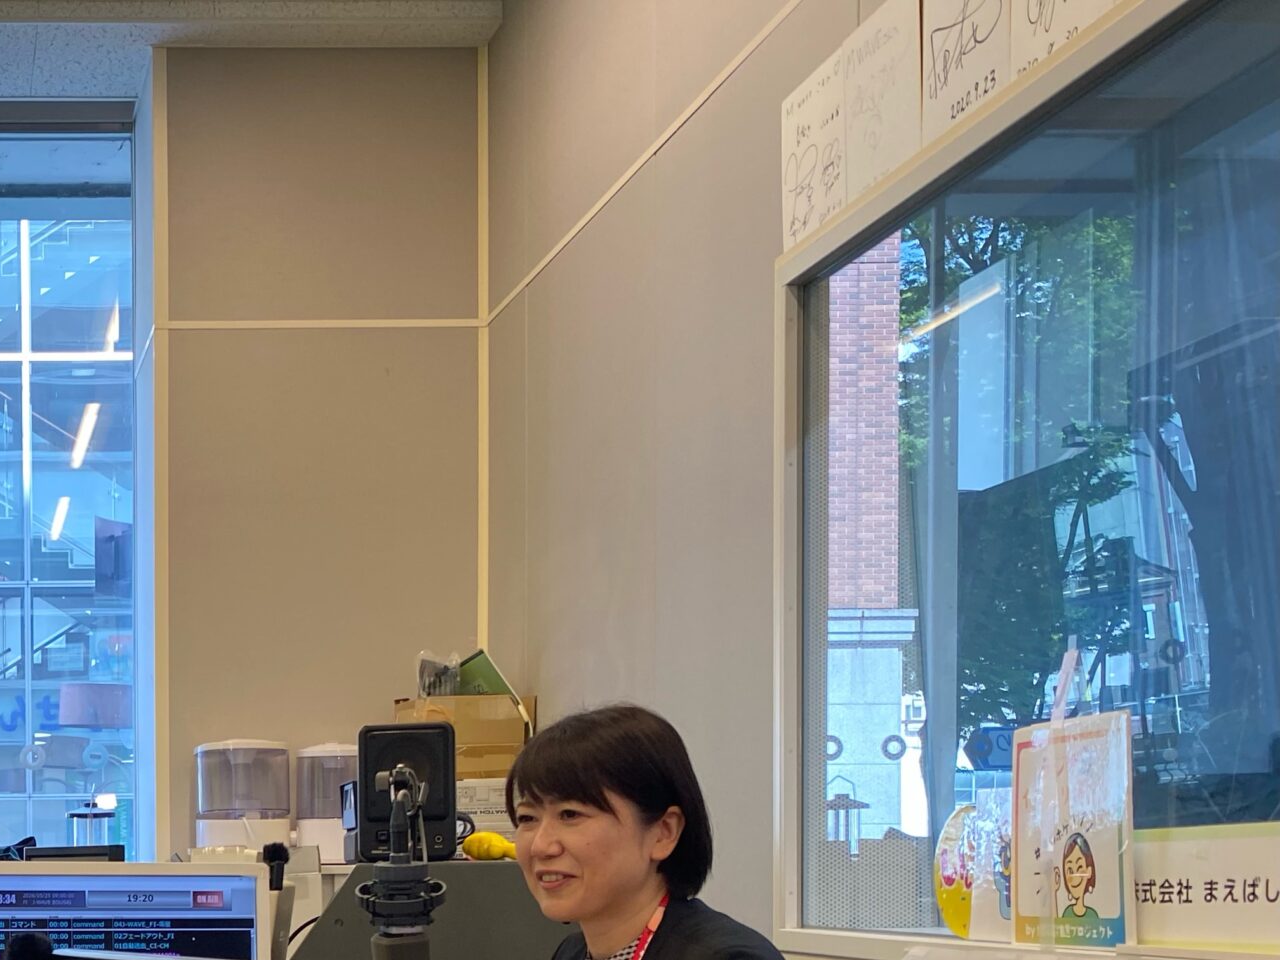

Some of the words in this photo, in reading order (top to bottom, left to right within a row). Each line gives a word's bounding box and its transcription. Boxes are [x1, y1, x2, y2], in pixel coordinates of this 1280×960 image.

[127, 894, 154, 903] 19:20
[1203, 876, 1280, 903] まえばし
